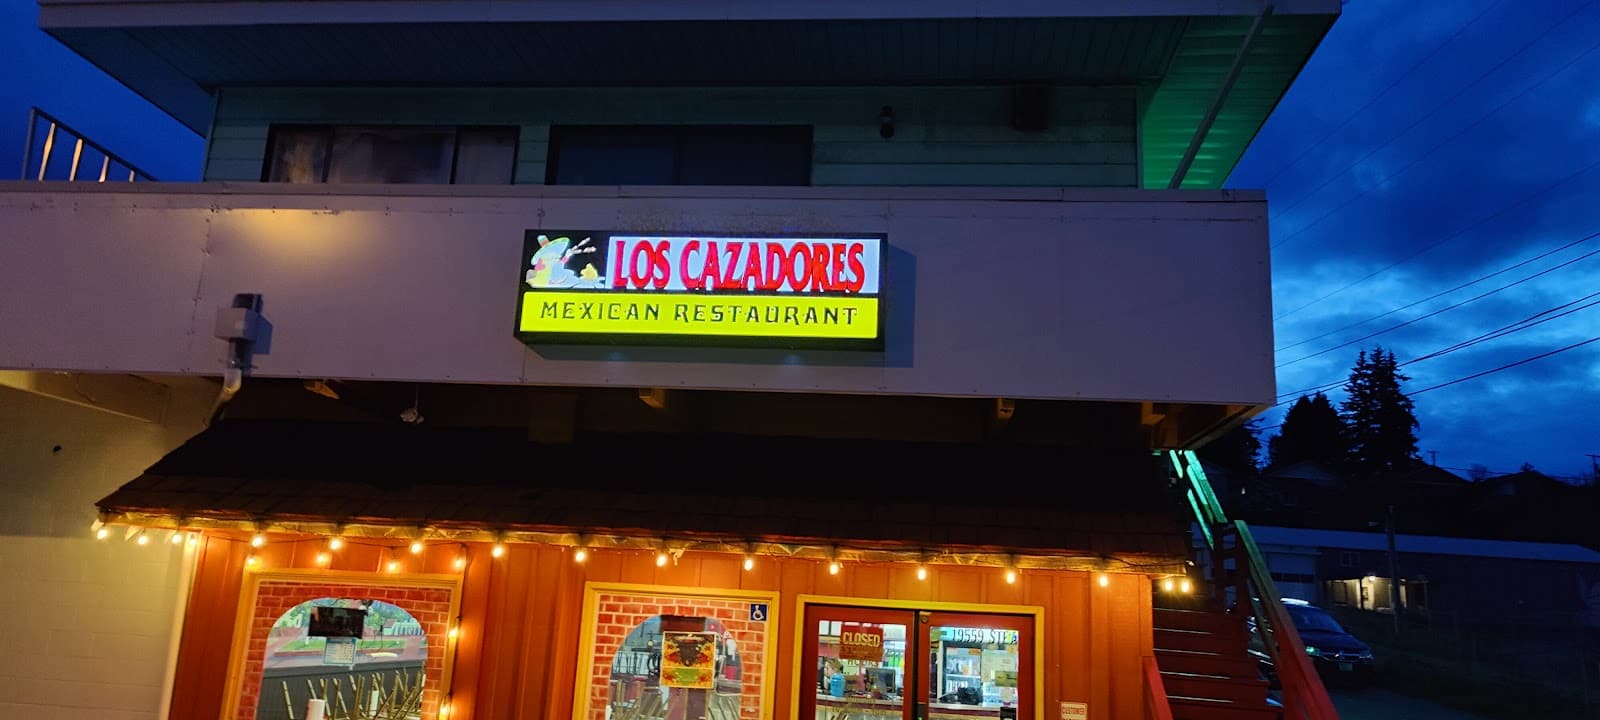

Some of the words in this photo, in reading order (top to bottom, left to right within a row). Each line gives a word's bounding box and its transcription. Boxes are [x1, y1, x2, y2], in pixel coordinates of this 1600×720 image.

[613, 240, 671, 289] LOS
[679, 240, 865, 294] CAZADORES
[540, 301, 660, 321] MEXICAN
[674, 303, 857, 326] RESTAURANT
[842, 631, 881, 648] CLOSED
[953, 628, 983, 644] 19559
